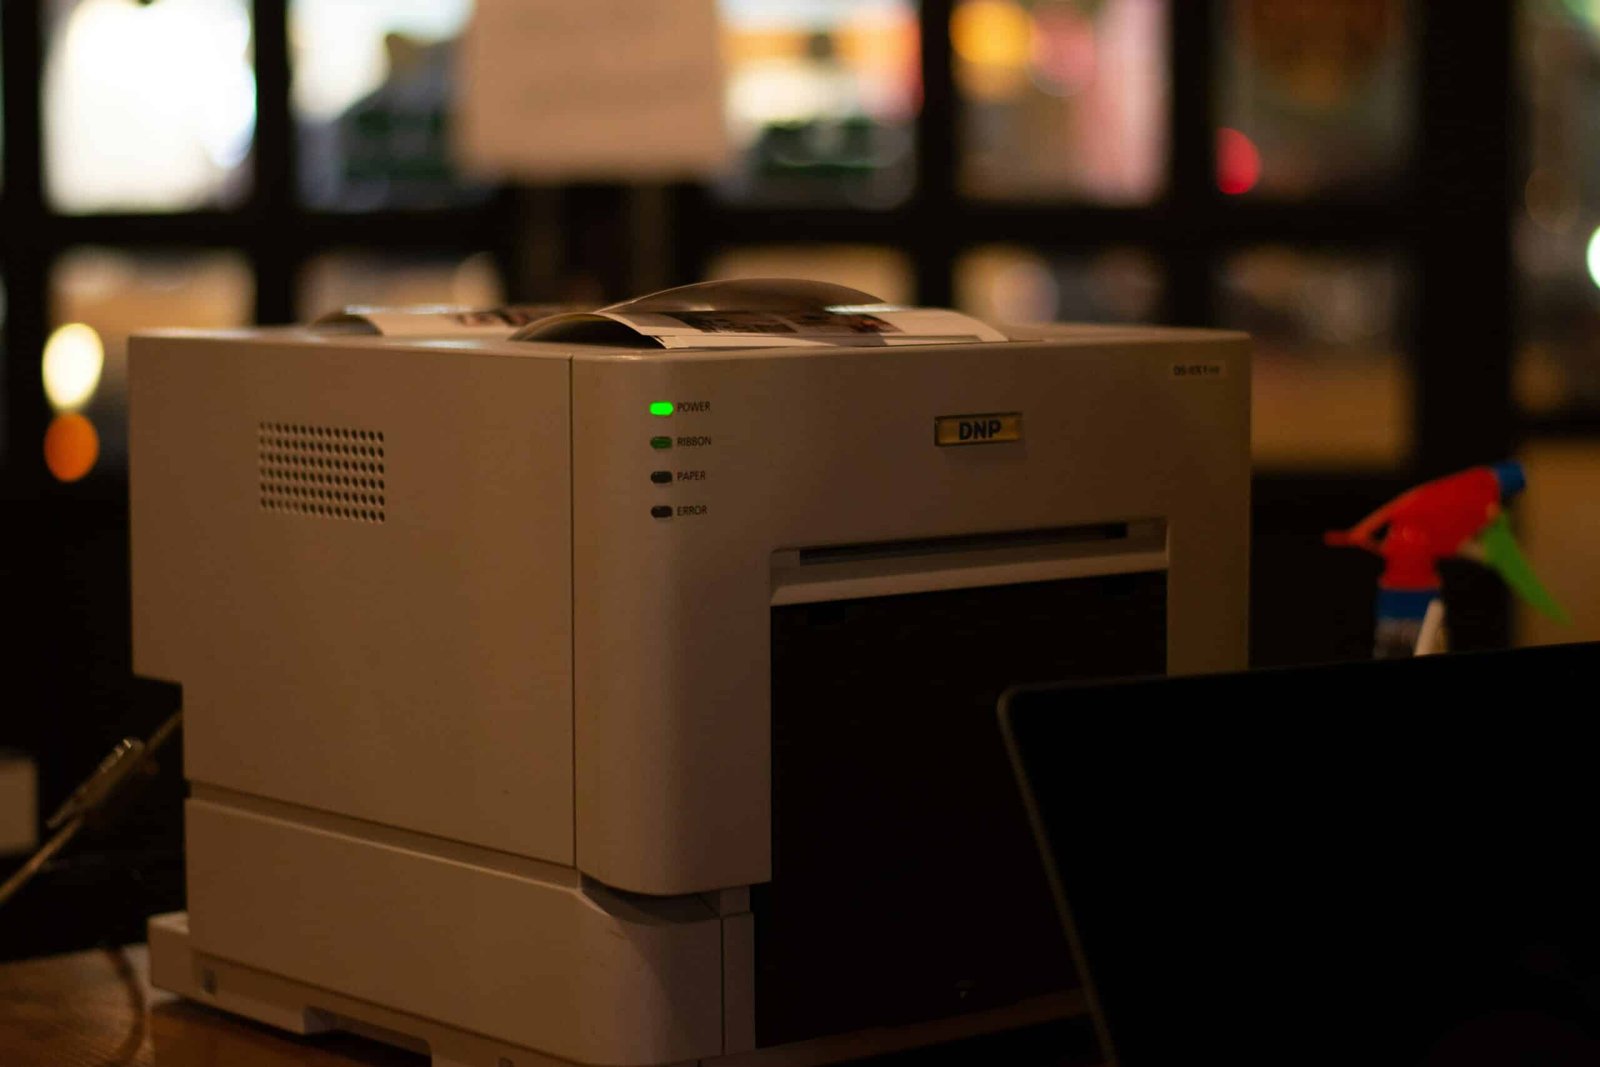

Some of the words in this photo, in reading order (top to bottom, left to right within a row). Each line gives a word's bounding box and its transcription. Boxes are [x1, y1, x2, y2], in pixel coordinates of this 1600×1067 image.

[677, 401, 711, 412] POWER
[959, 419, 1001, 440] DNP
[677, 436, 711, 447] RIBBON
[677, 471, 706, 481] PAPER
[677, 505, 707, 516] ERROR
